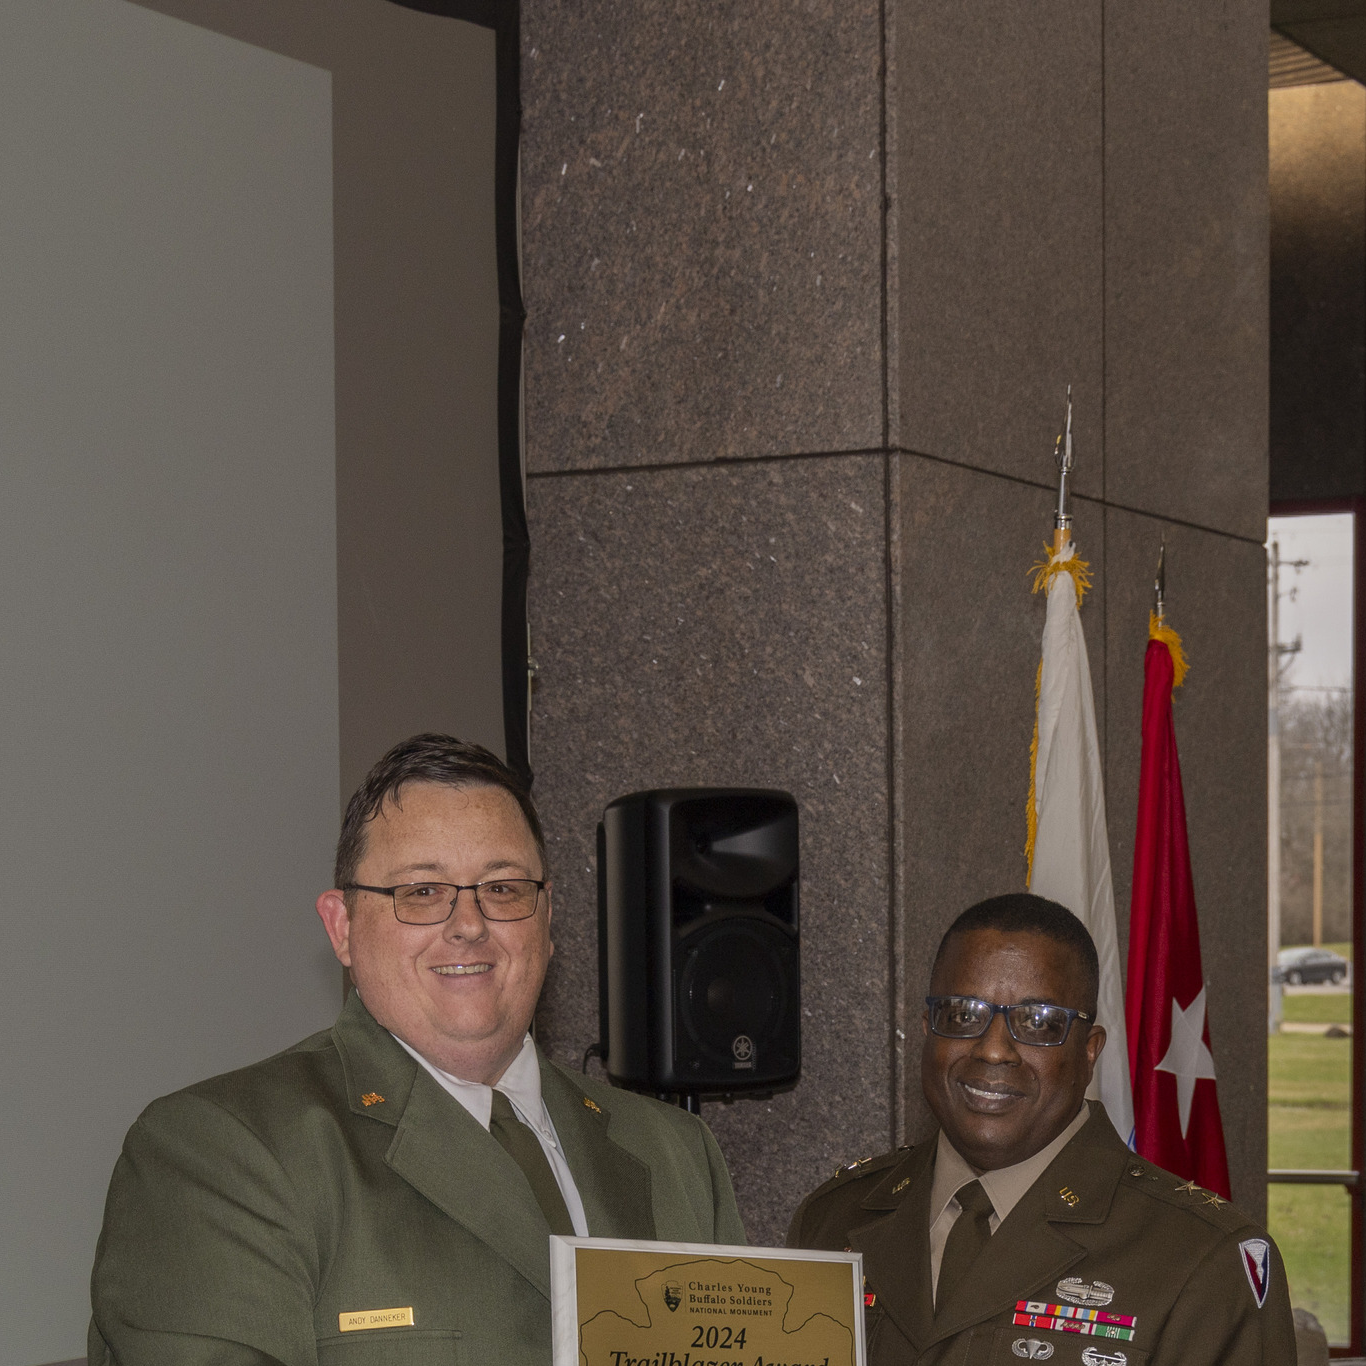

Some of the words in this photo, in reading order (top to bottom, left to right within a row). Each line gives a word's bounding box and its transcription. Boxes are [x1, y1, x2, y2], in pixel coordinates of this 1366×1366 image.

[688, 1281, 733, 1293] Charles
[737, 1283, 772, 1296] Young
[689, 1294, 727, 1305] Buffalo
[729, 1295, 772, 1307] Soldiers
[689, 1307, 727, 1315] NATIONAL
[729, 1308, 773, 1317] MONUMENT
[348, 1317, 366, 1326] ANDY
[690, 1325, 747, 1350] 2024
